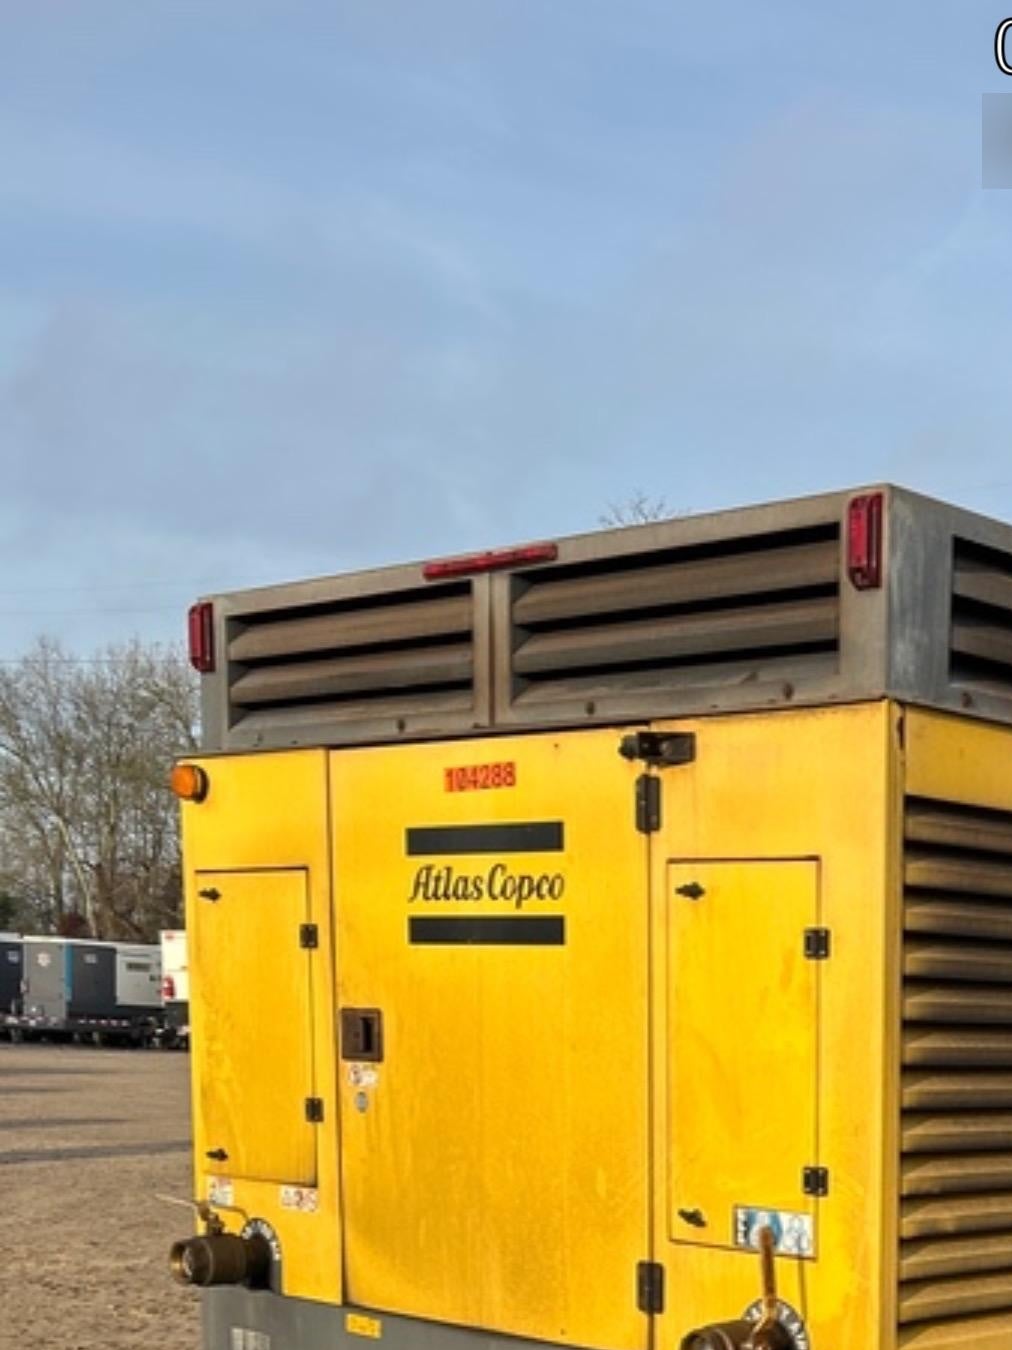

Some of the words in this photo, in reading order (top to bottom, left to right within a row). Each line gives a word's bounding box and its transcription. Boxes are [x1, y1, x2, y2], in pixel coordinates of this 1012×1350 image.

[445, 761, 516, 792] 104288
[408, 864, 483, 903] Atlas
[487, 863, 565, 909] Copco
